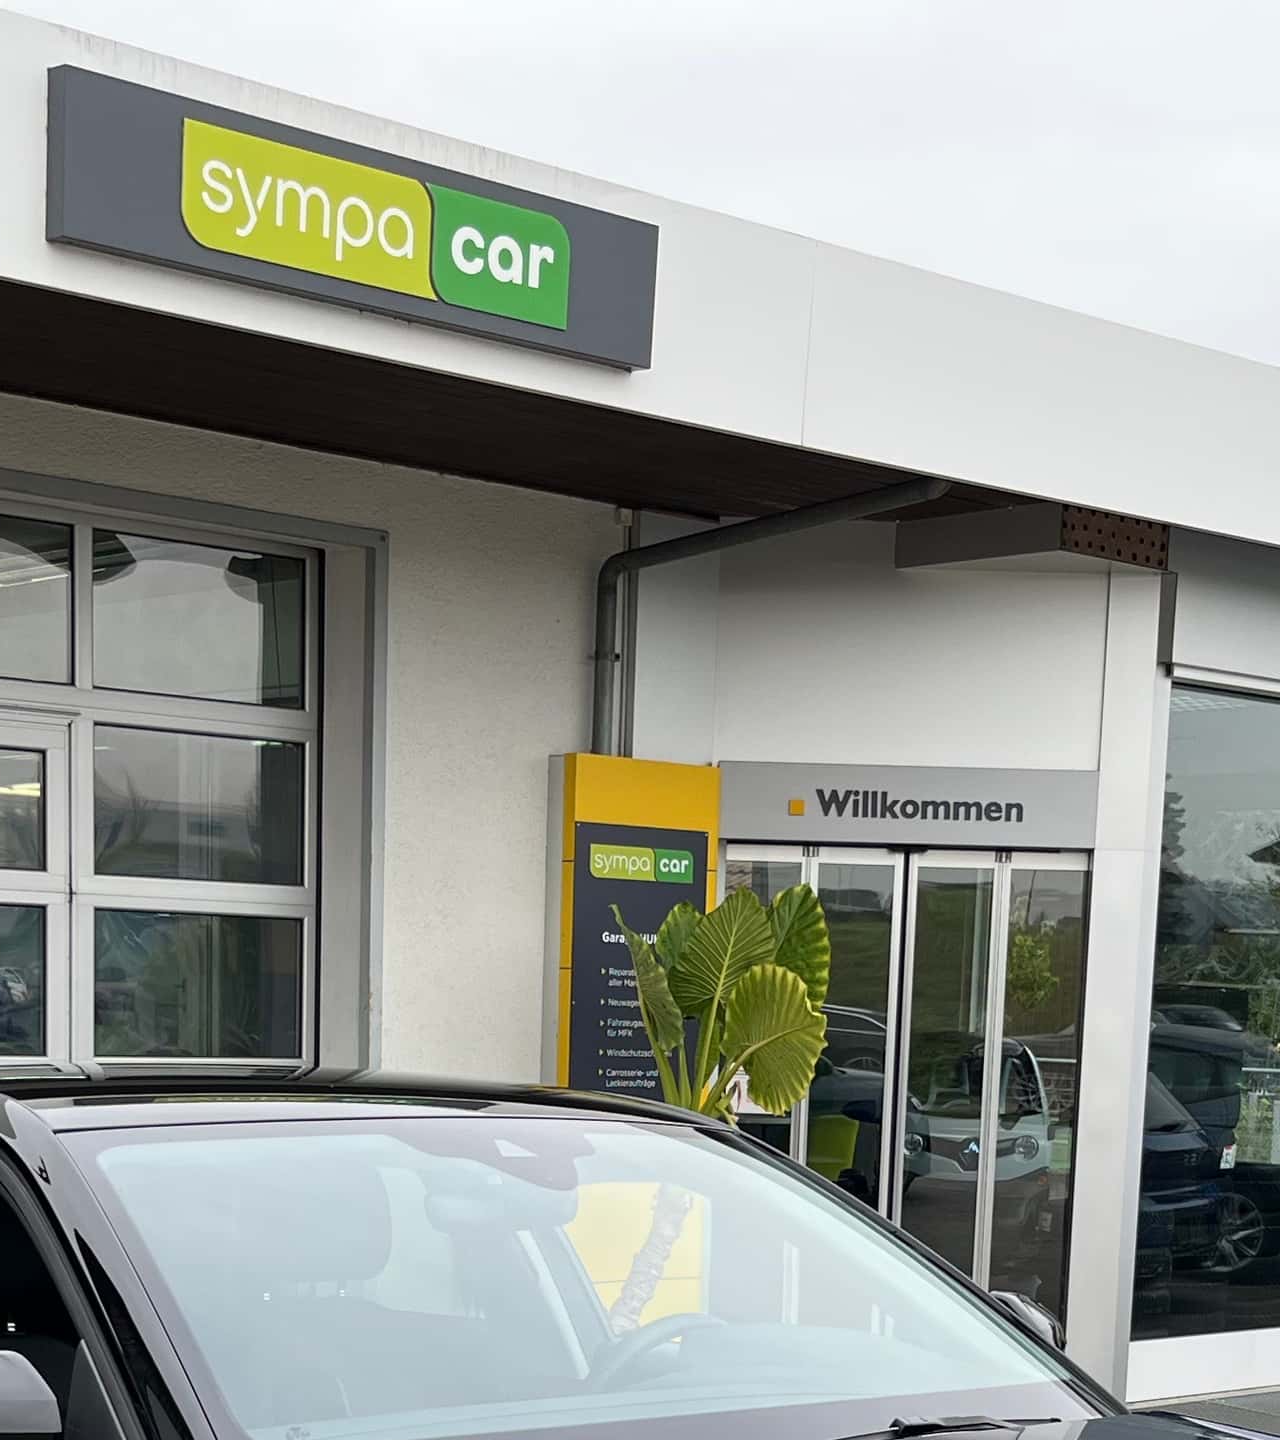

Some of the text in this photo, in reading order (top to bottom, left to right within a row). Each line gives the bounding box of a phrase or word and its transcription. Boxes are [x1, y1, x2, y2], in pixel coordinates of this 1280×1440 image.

[201, 159, 555, 290] sympa car
[815, 788, 1024, 823] Willkommen
[594, 853, 689, 876] sympa car
[601, 930, 628, 946] Gara
[645, 1068, 659, 1077] und
